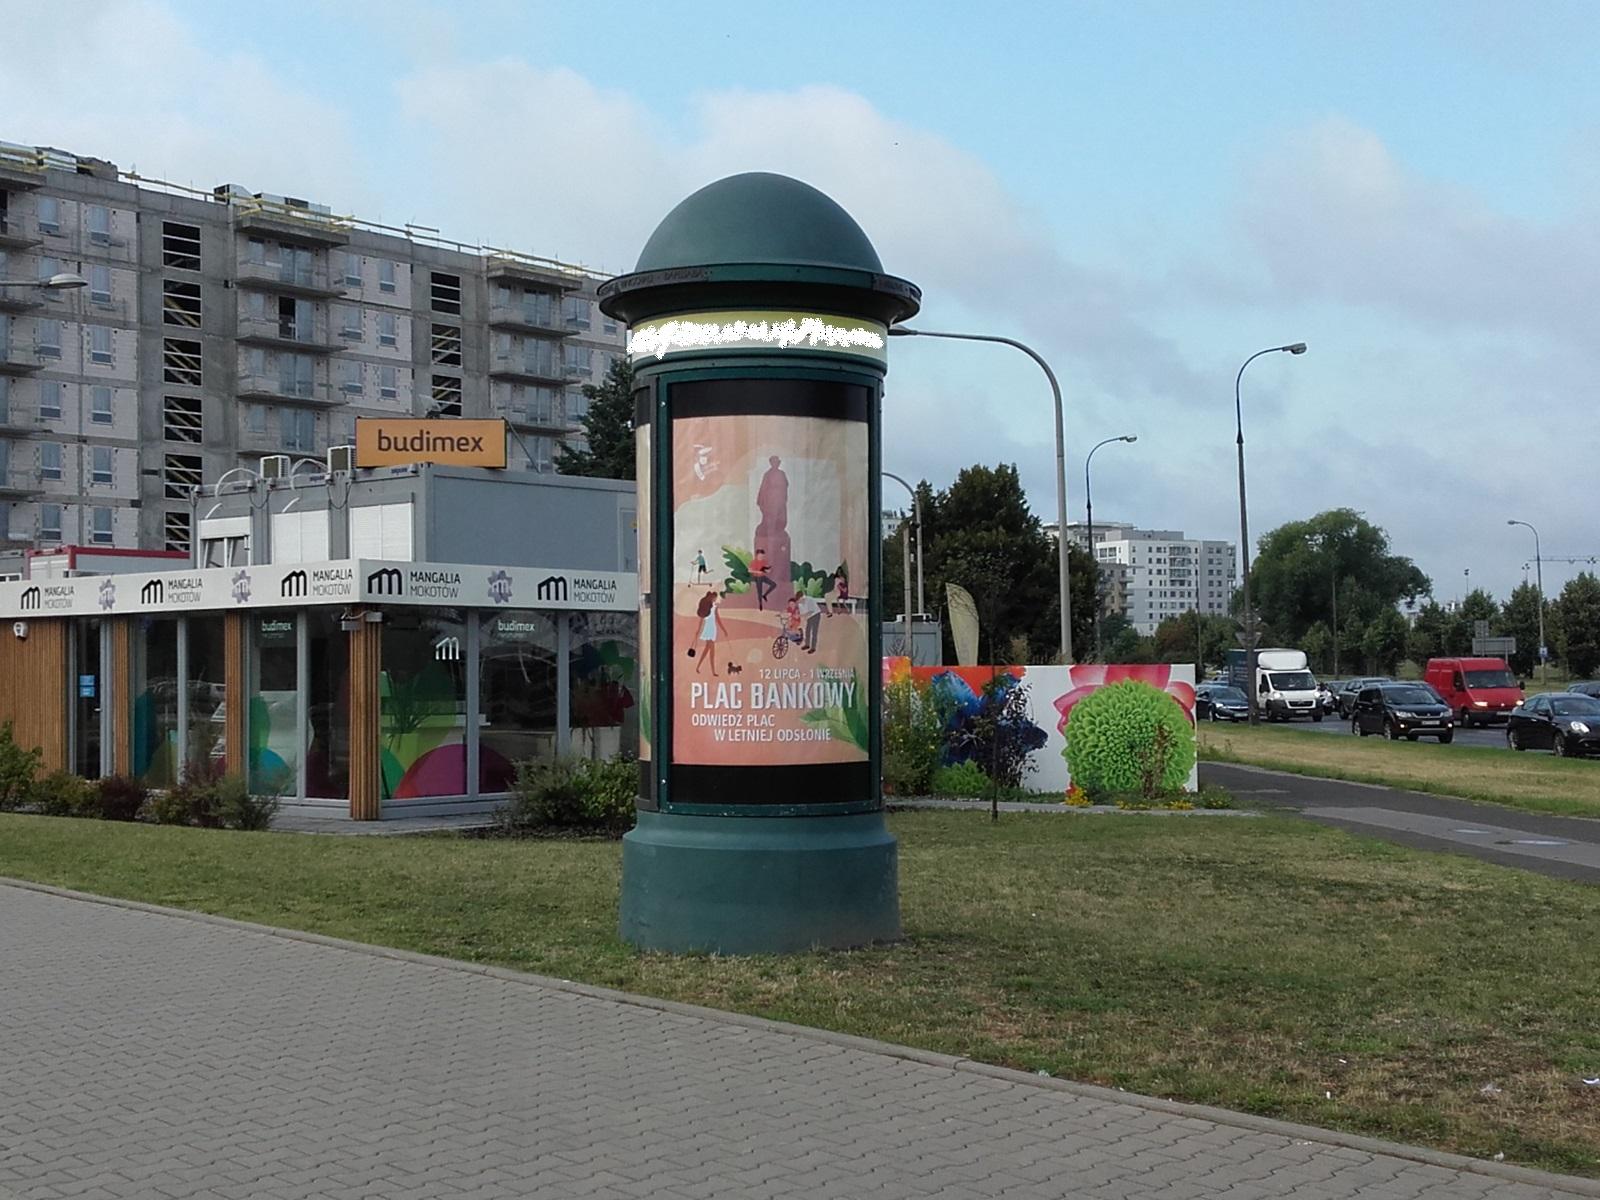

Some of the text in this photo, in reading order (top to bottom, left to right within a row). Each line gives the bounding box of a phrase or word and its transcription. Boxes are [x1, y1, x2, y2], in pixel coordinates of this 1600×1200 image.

[378, 429, 484, 452] budimex
[312, 568, 353, 582] MANGALIA
[410, 571, 461, 585] MANGALIA
[167, 577, 204, 589] MANGALIA
[573, 578, 617, 591] MANGALIA
[44, 585, 75, 597] MANGALIA
[497, 619, 536, 632] budimex
[759, 668, 771, 679] 12
[774, 668, 801, 680] LIPCA
[690, 682, 856, 709] PLAC BANKOWY
[746, 714, 776, 727] PLAC
[714, 728, 832, 742] W LETNIEJ ODSŁONIE
